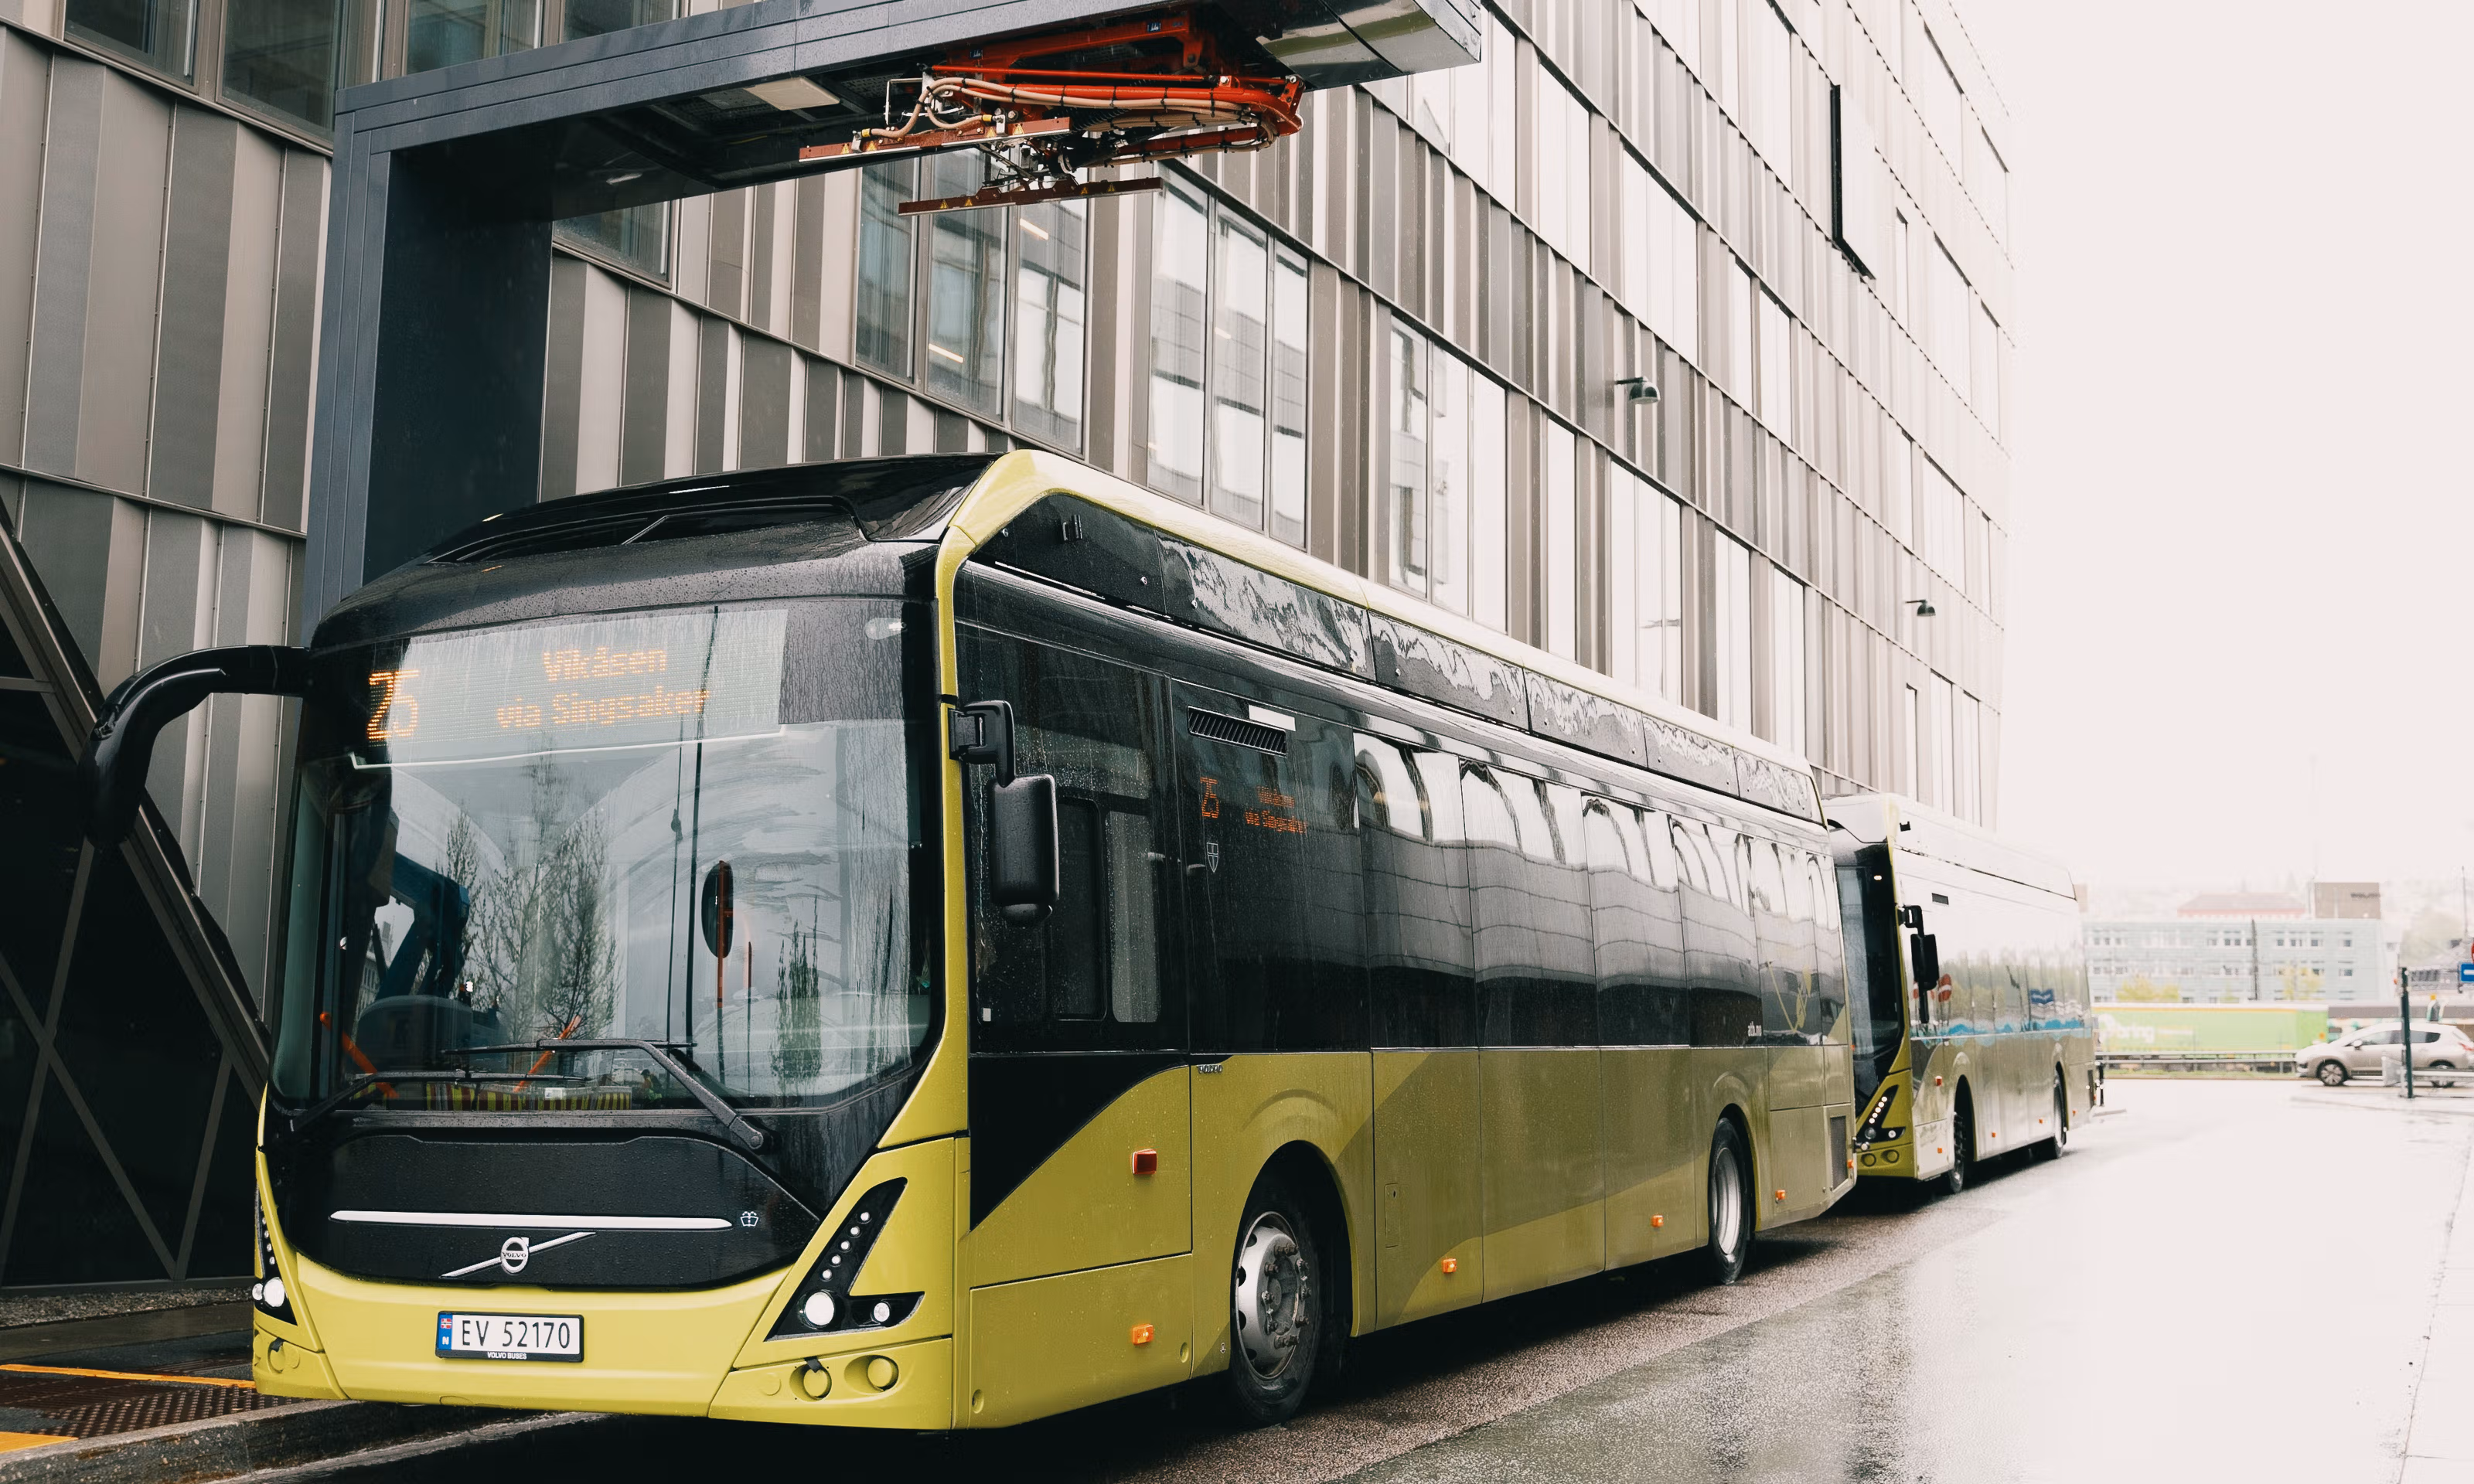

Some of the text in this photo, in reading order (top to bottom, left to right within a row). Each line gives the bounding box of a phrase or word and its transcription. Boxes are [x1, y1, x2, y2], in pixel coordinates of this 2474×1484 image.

[544, 647, 667, 682] Vikåsen
[367, 670, 420, 740] 25
[497, 686, 710, 728] via Singsaker
[1200, 777, 1219, 819] 25
[442, 1336, 449, 1345] N
[462, 1320, 571, 1349] EV 52170
